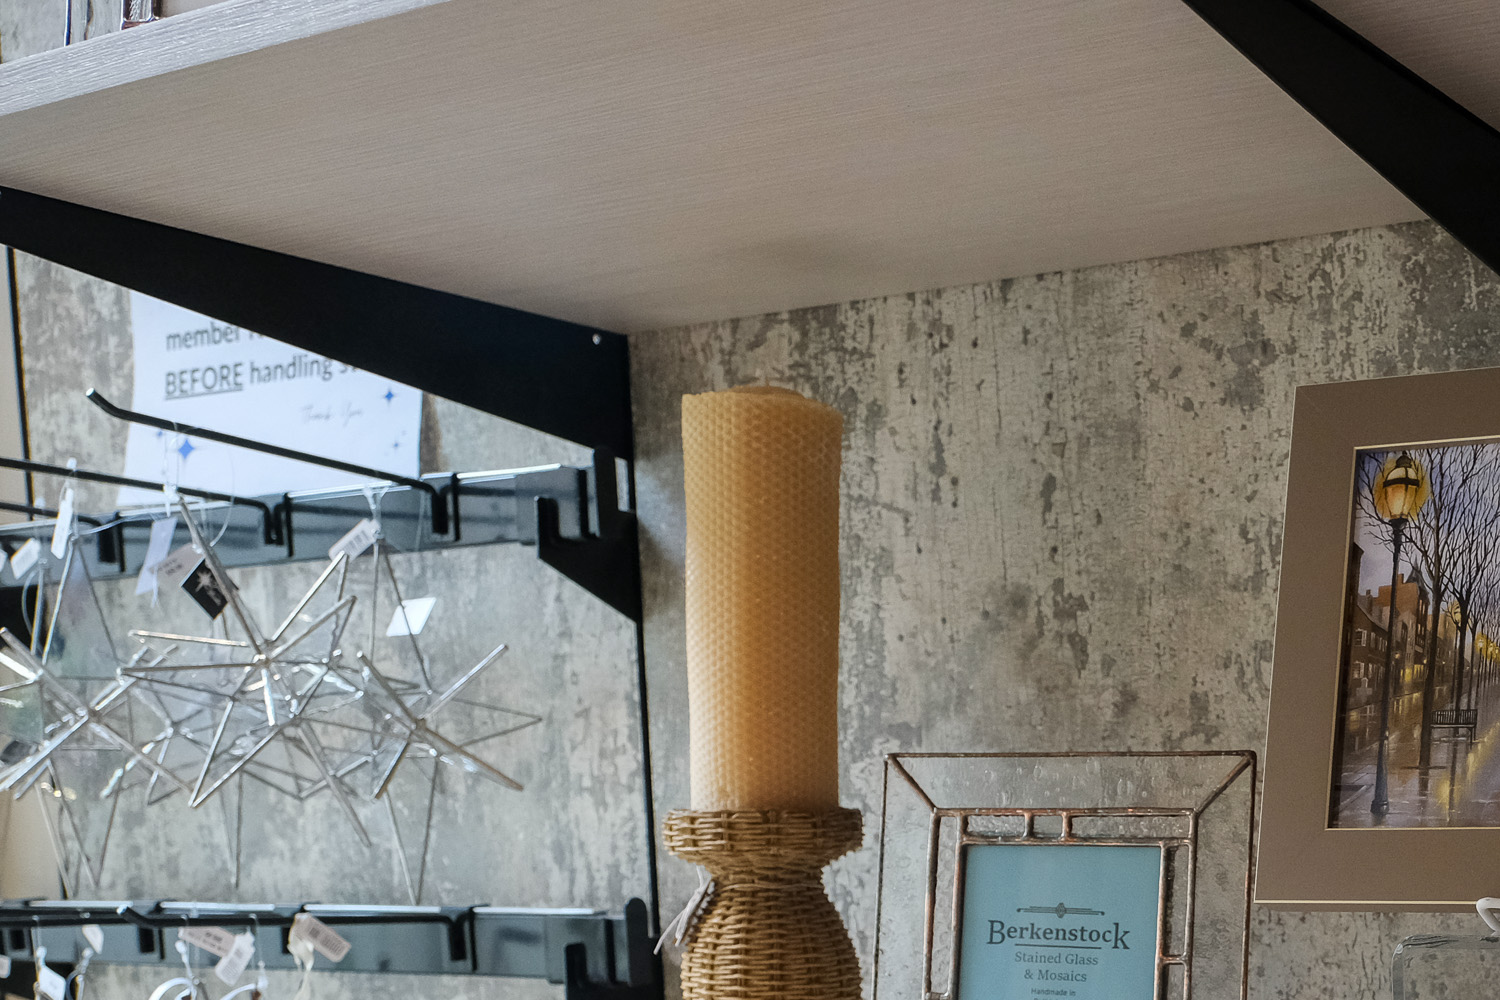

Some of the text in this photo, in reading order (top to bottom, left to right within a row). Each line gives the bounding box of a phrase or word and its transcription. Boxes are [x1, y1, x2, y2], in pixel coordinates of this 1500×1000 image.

[166, 322, 240, 351] member
[165, 354, 333, 396] BEFORE handling
[986, 919, 1131, 949] Berkenstock
[1014, 951, 1099, 965] Stained Glass
[1024, 969, 1087, 982] & Mosaics
